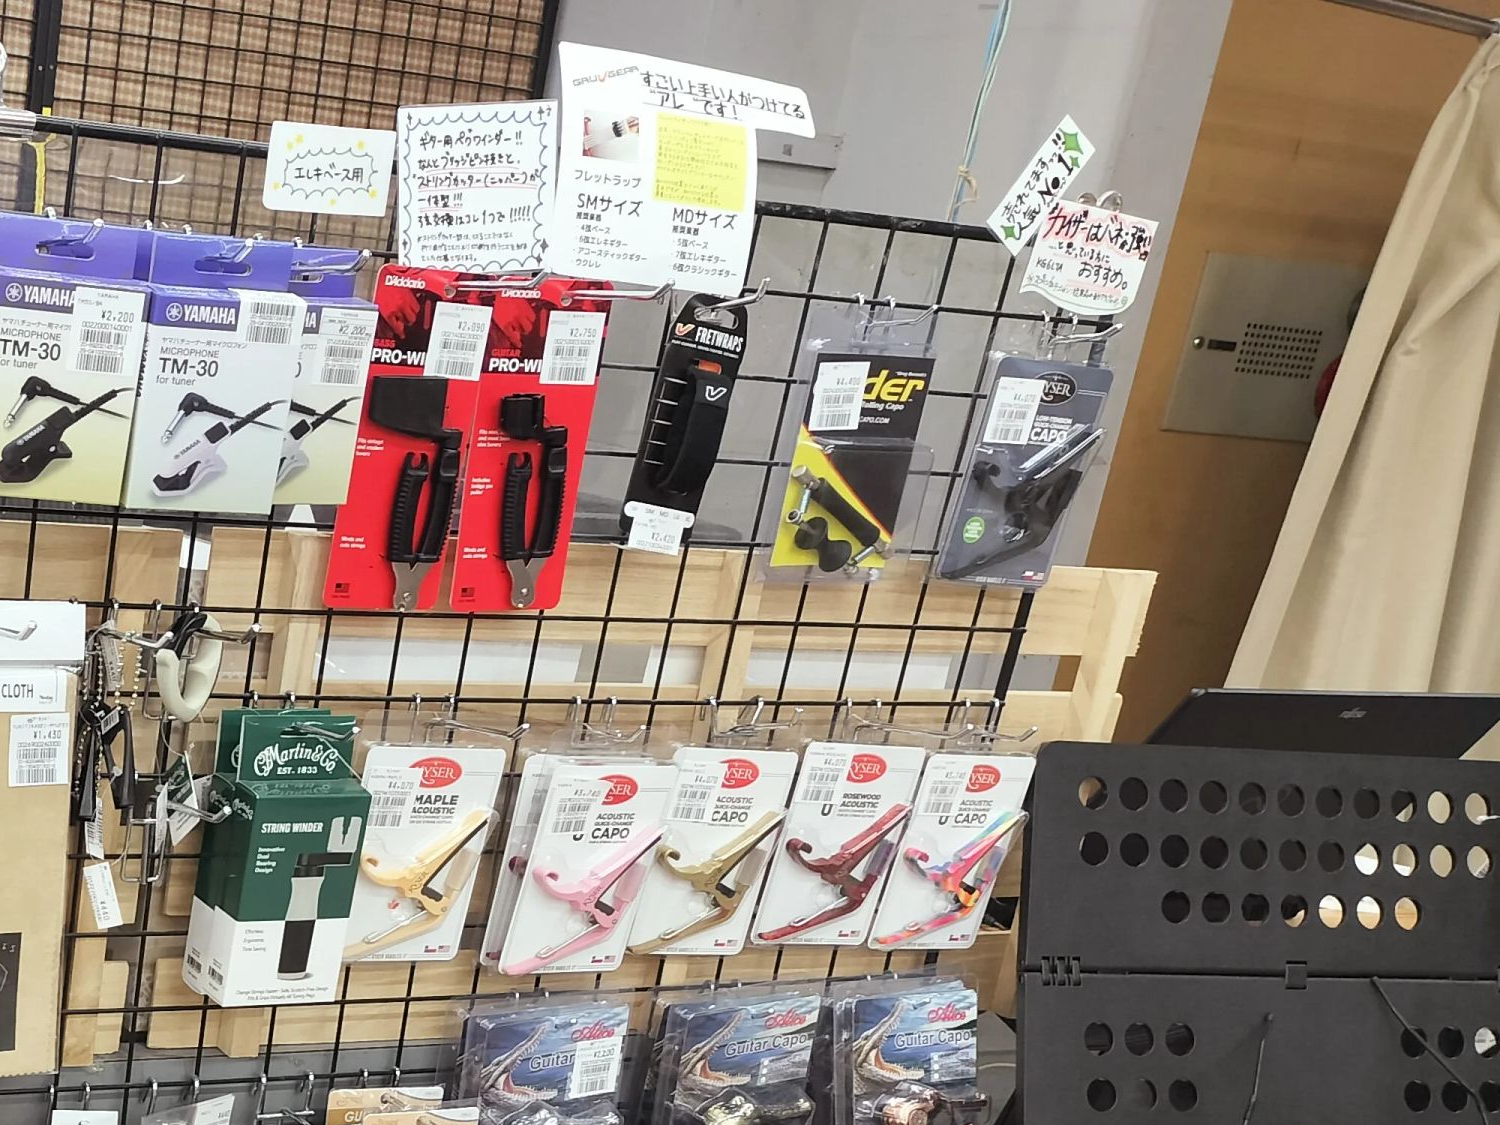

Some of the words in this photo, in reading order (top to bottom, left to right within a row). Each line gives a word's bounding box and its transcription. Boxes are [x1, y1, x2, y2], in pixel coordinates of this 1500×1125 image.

[293, 165, 364, 185] エレキベース用
[574, 169, 642, 189] フレットラップ
[577, 193, 643, 217] SMサイズ
[672, 207, 738, 231] MDサイズ
[385, 274, 426, 290] D'Addario
[23, 284, 76, 307] YAMAHA
[182, 307, 237, 326] YAMAHA
[0, 328, 62, 342] MICROPHONE
[695, 327, 745, 353] FRETWRAPS
[0, 340, 61, 361] TM-30
[160, 346, 220, 358] MICROPHONE
[12, 361, 38, 370] tuner
[159, 358, 219, 378] TM-30
[156, 375, 169, 384] for
[171, 377, 197, 387] tuner
[1030, 428, 1068, 443] CAPO
[1, 683, 34, 699] CLOTH
[296, 765, 318, 774] 1833
[711, 810, 749, 824] CAPO
[954, 811, 988, 825] CAPO
[260, 822, 290, 834] STRING
[291, 821, 324, 833] WINDER
[591, 827, 630, 841] CAPO
[764, 1008, 808, 1031] Alice
[927, 1002, 967, 1024] Alice
[725, 1040, 769, 1058] Guitar
[771, 1034, 809, 1052] Capo
[895, 1032, 935, 1050] Guitar
[937, 1028, 972, 1046] Capo
[529, 1054, 575, 1072] Guitar
